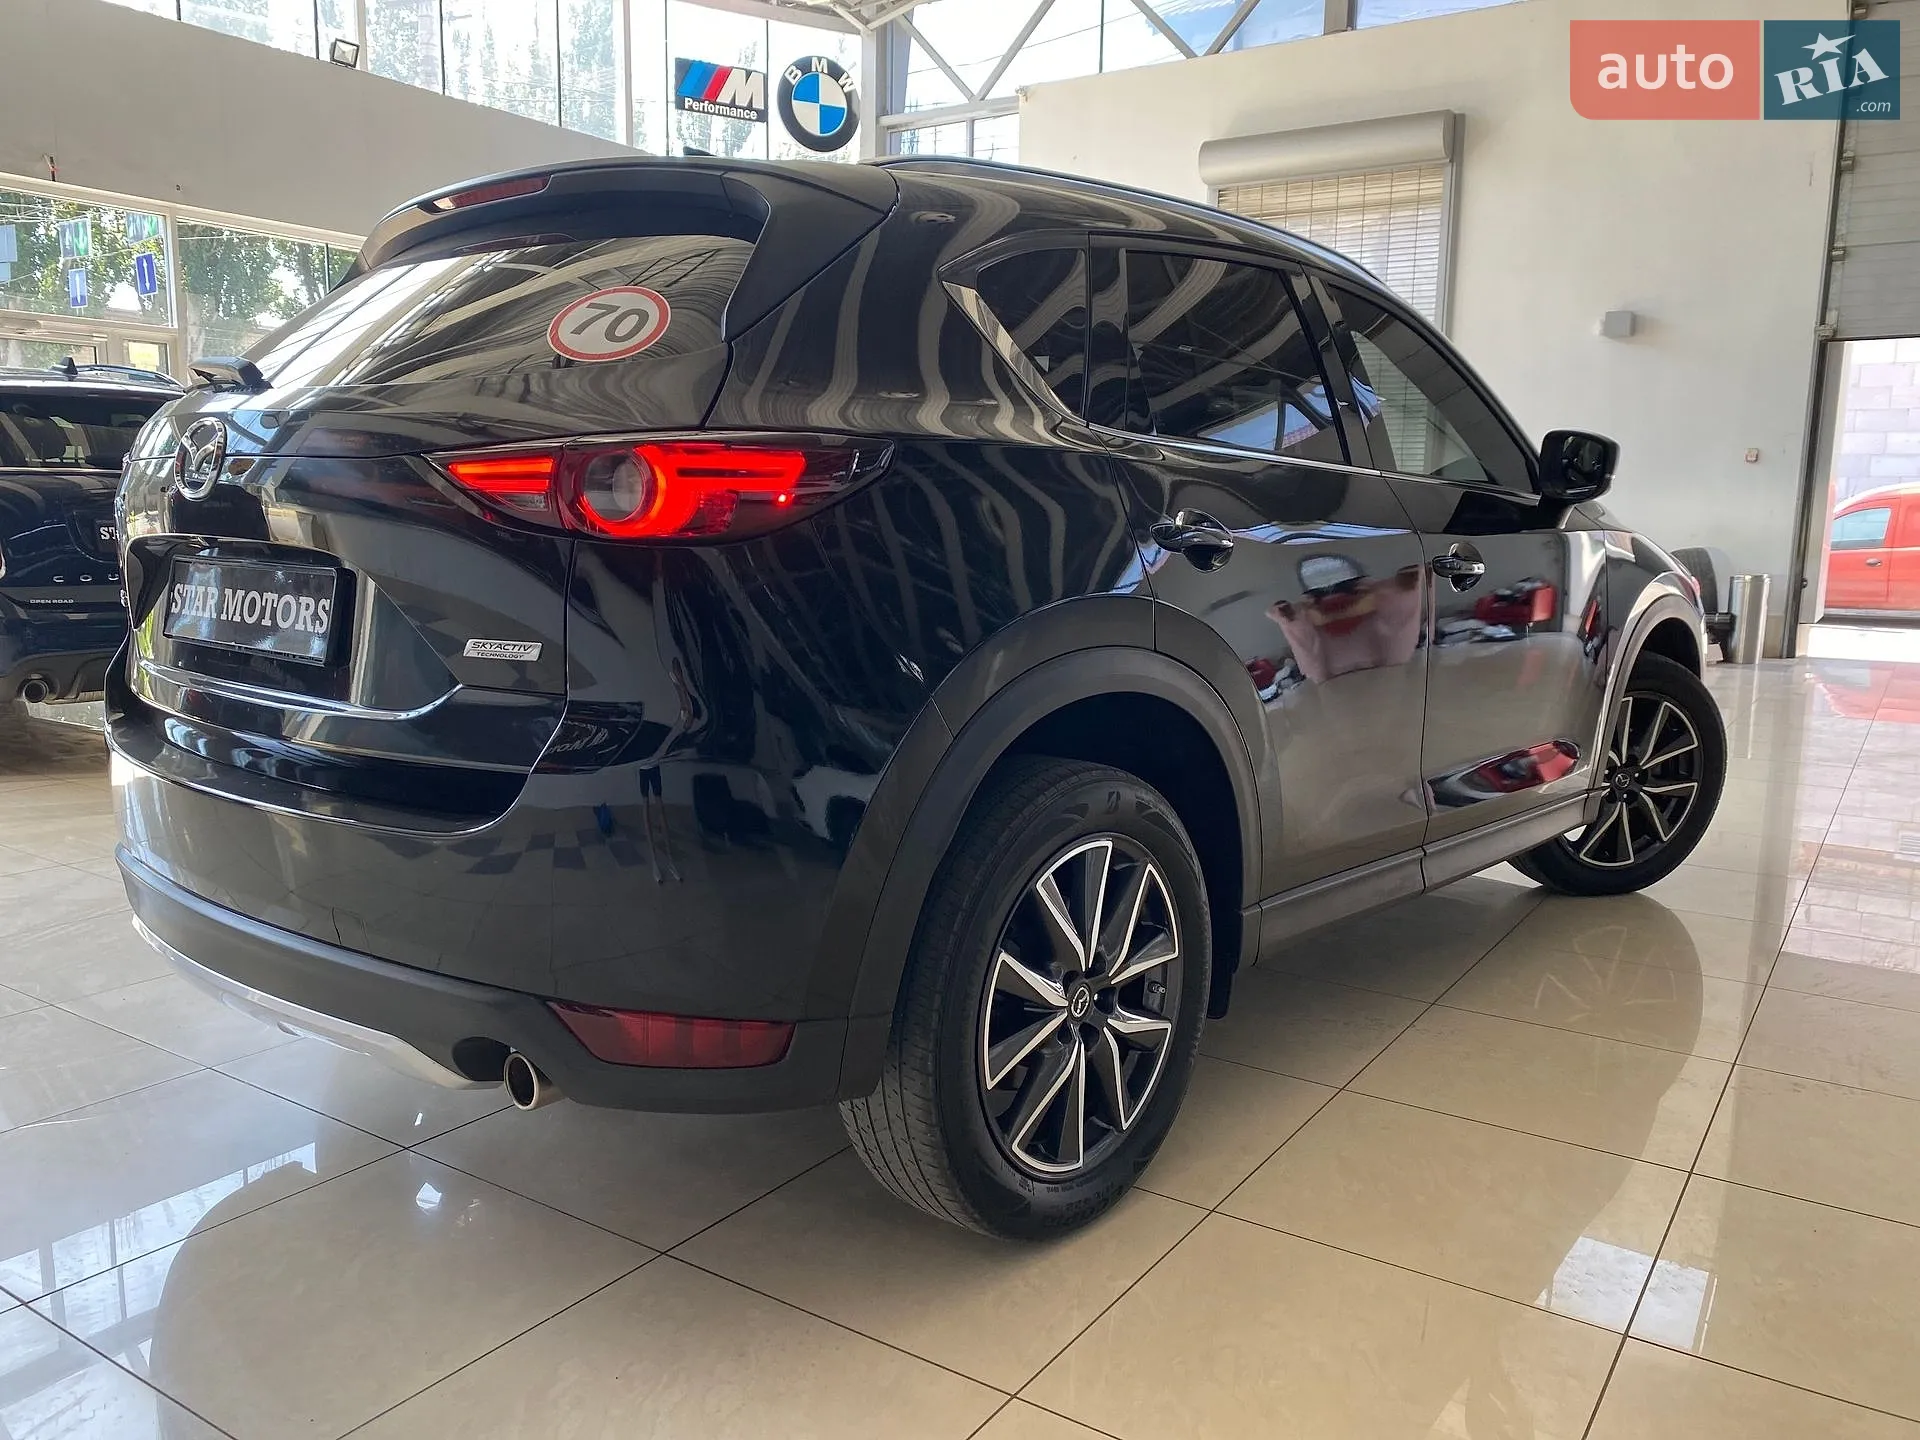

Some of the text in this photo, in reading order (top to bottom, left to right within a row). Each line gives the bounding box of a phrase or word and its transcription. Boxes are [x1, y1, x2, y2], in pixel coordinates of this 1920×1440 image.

[784, 57, 856, 94] BMW
[684, 97, 758, 120] Performance
[570, 302, 650, 343] 70
[170, 583, 331, 634] STAR MOTORS
[471, 641, 533, 652] SKYACTIV
[476, 651, 524, 659] TECHNOLOGY
